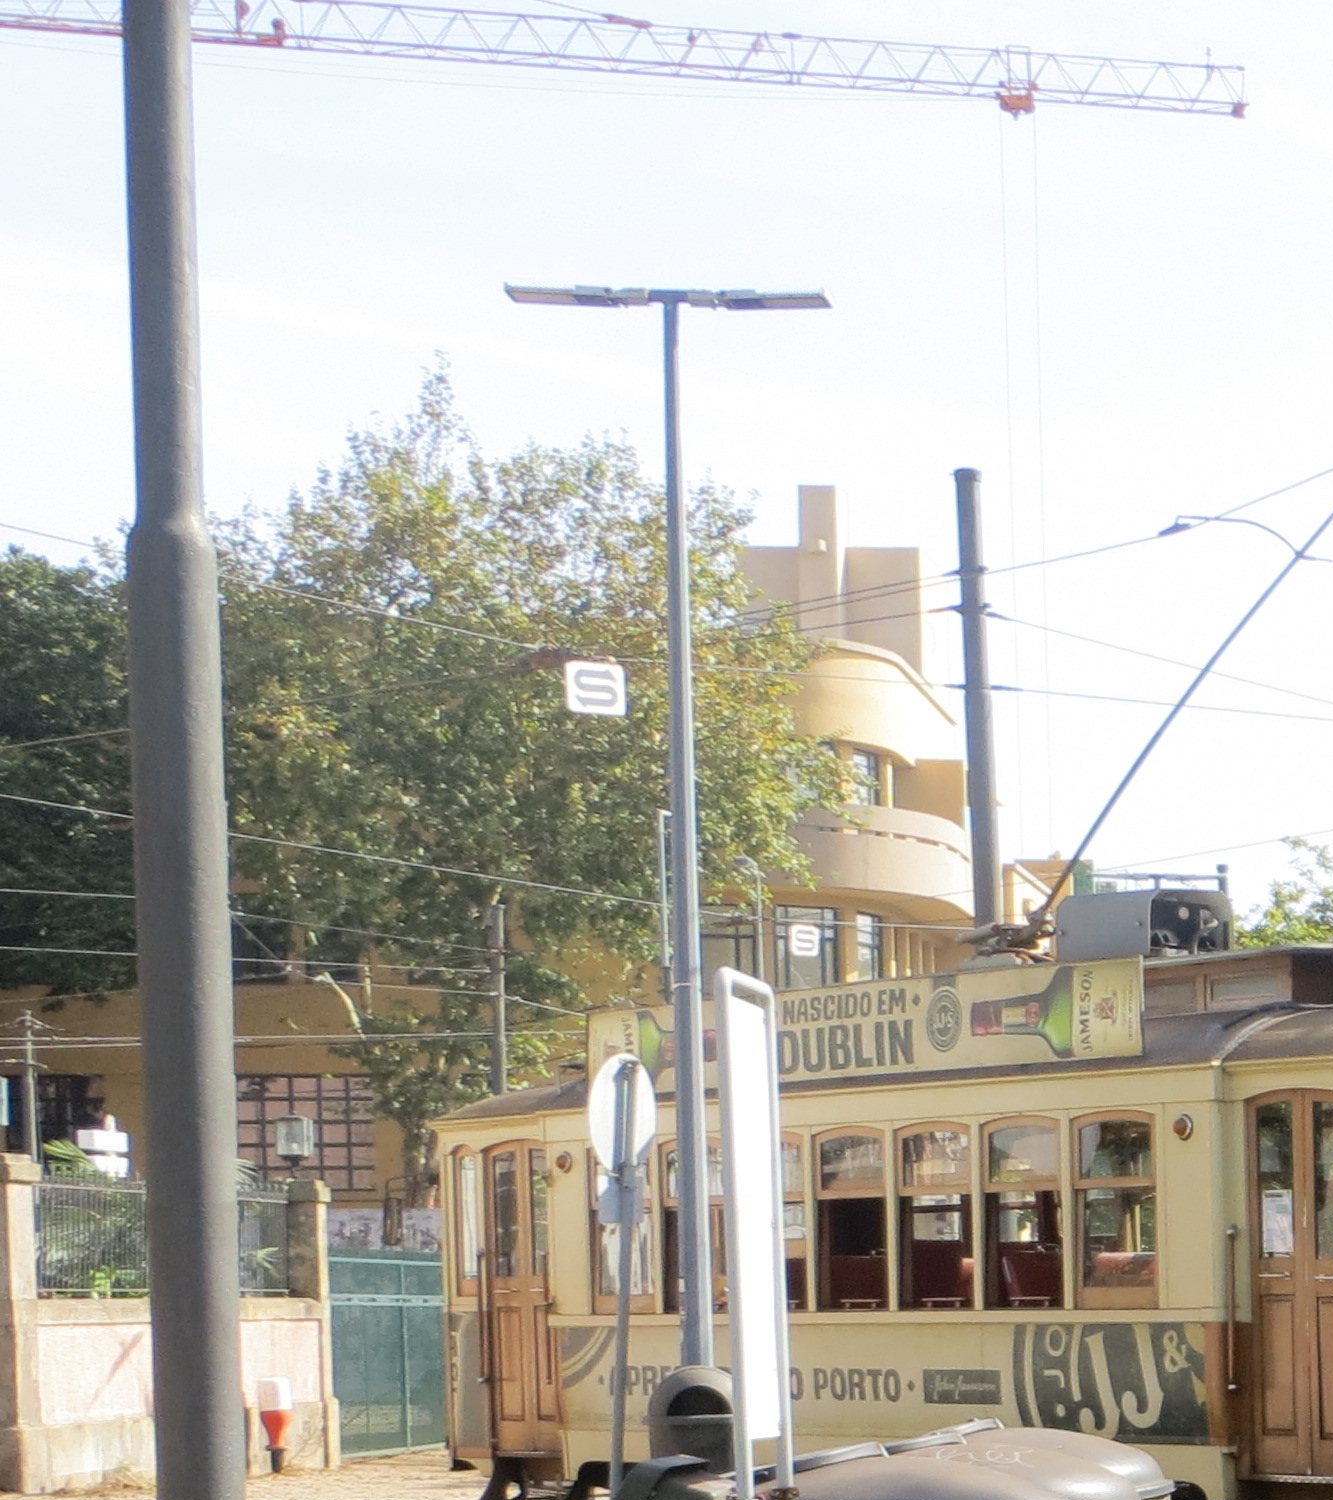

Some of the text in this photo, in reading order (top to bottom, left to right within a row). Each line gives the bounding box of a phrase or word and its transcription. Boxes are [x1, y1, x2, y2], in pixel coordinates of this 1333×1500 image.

[782, 987, 907, 1025] NASCIDO EM
[1080, 968, 1094, 1053] JAMESON
[778, 1018, 915, 1075] DUBLIN
[812, 1367, 901, 1403] PORTO
